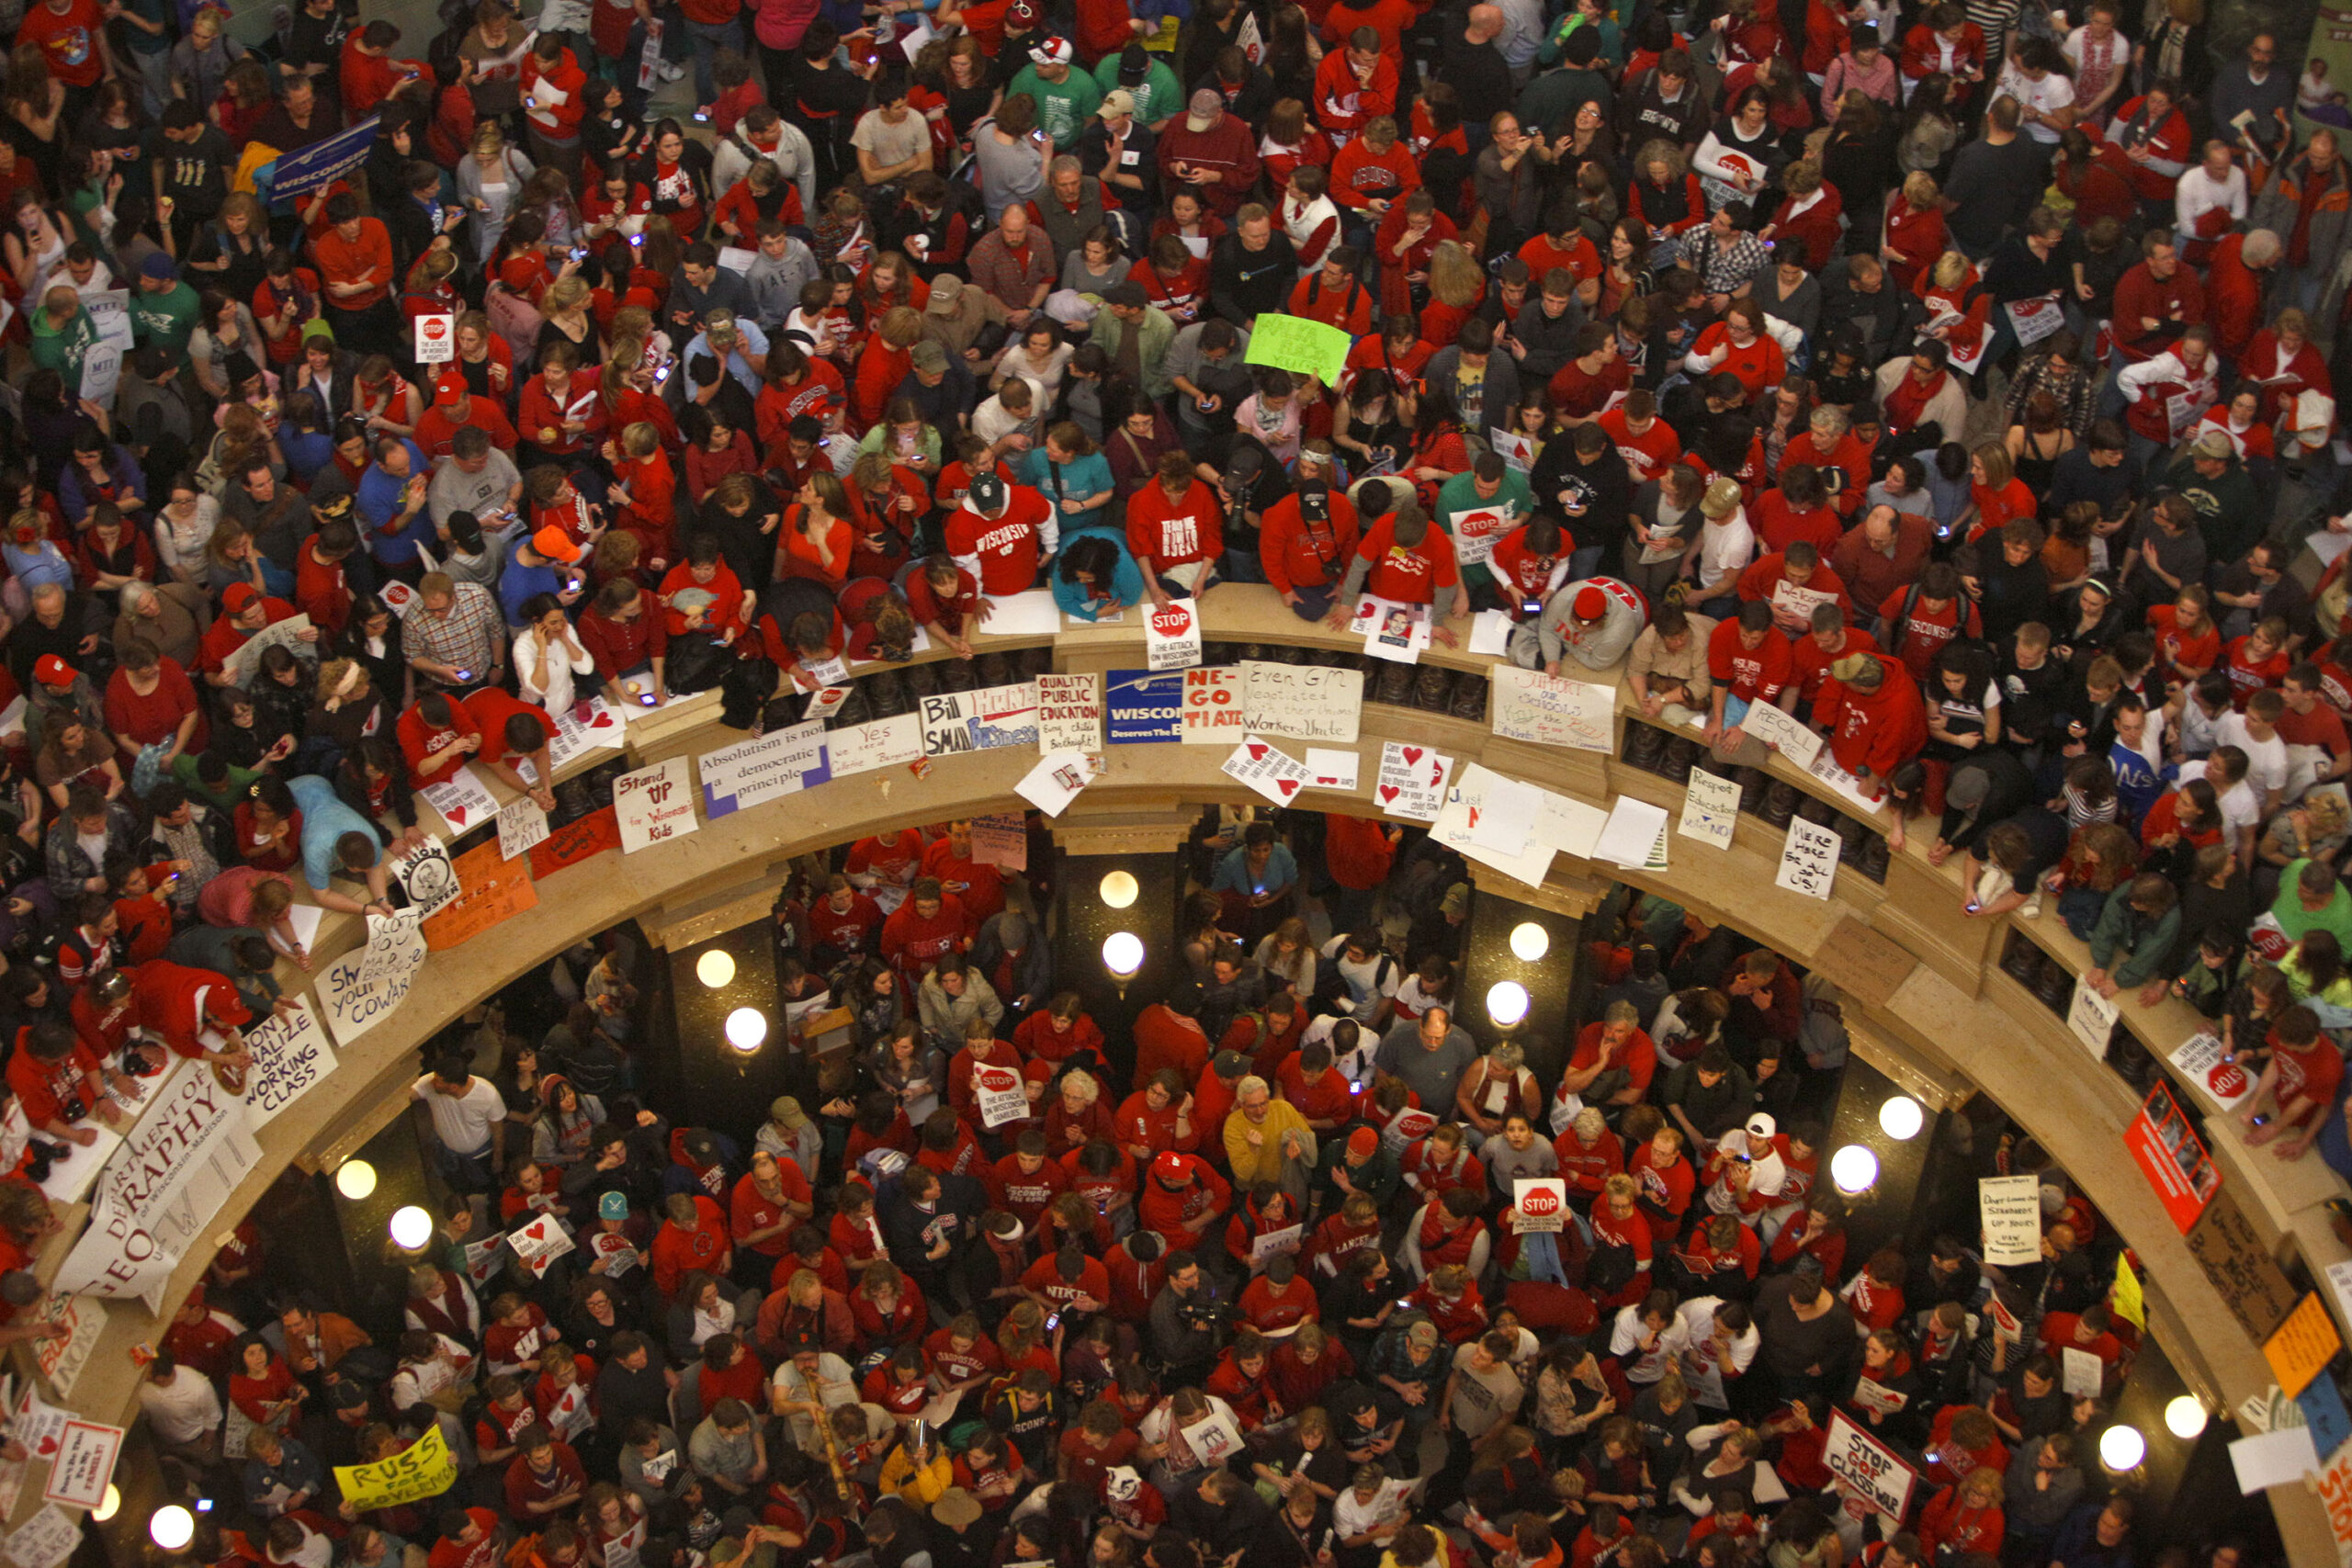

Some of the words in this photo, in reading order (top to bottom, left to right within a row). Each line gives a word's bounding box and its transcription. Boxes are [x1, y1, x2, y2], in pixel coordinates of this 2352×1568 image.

[424, 324, 445, 333] STOP
[786, 383, 829, 417] WISCONSIN
[1462, 519, 1497, 534] STOP
[976, 523, 1030, 553] WISCONSIN
[388, 588, 408, 601] STOP
[1153, 613, 1189, 628] STOP
[1151, 653, 1161, 662] ON
[1161, 649, 1200, 661] WISCONSIN
[1155, 644, 1168, 653] THE
[1169, 641, 1194, 652] ATTACK
[1160, 660, 1191, 670] FAMILIES
[1039, 675, 1095, 689] QUALITY
[1250, 663, 1295, 687] Even
[1304, 668, 1347, 688] GM
[1041, 690, 1091, 704] PUBLIC
[1189, 689, 1232, 707] GO
[923, 695, 963, 725] Bill
[1040, 705, 1100, 721] EDUCATION
[1111, 728, 1153, 739] Deserves
[1154, 728, 1171, 739] The
[1757, 707, 1812, 752] RECALL
[701, 737, 783, 773] Absolutism
[786, 730, 798, 744] is
[801, 724, 825, 739] not
[1385, 743, 1400, 753] Care
[713, 777, 722, 788] a
[737, 747, 816, 780] democratic
[1382, 765, 1412, 778] educators
[618, 765, 666, 796] Stand
[737, 769, 803, 800] principle
[646, 781, 673, 806] UP
[648, 823, 674, 842] Kids
[417, 885, 459, 919] BUSTER
[351, 969, 419, 1024] COWAR
[261, 1050, 284, 1074] our
[182, 1068, 207, 1100] OF
[245, 1043, 319, 1107] WORKING
[983, 1077, 1013, 1086] STOP
[2213, 1066, 2245, 1095] STOP
[263, 1064, 317, 1111] CLASS
[984, 1108, 993, 1117] ON
[993, 1099, 1026, 1114] WISCONSIN
[985, 1096, 997, 1105] THE
[998, 1092, 1022, 1103] ATTACK
[993, 1110, 1022, 1122] FAMILIES
[1524, 1198, 1557, 1212] STOP
[510, 1233, 526, 1246] Care
[516, 1240, 535, 1255] about
[1047, 1284, 1087, 1300] NIKE
[352, 1435, 439, 1489] RUSS
[1848, 1433, 1893, 1475] STOP
[1847, 1450, 1882, 1481] GOP
[385, 1471, 427, 1491] FOR
[1830, 1453, 1874, 1496] CLASS
[1874, 1488, 1899, 1516] WAR
